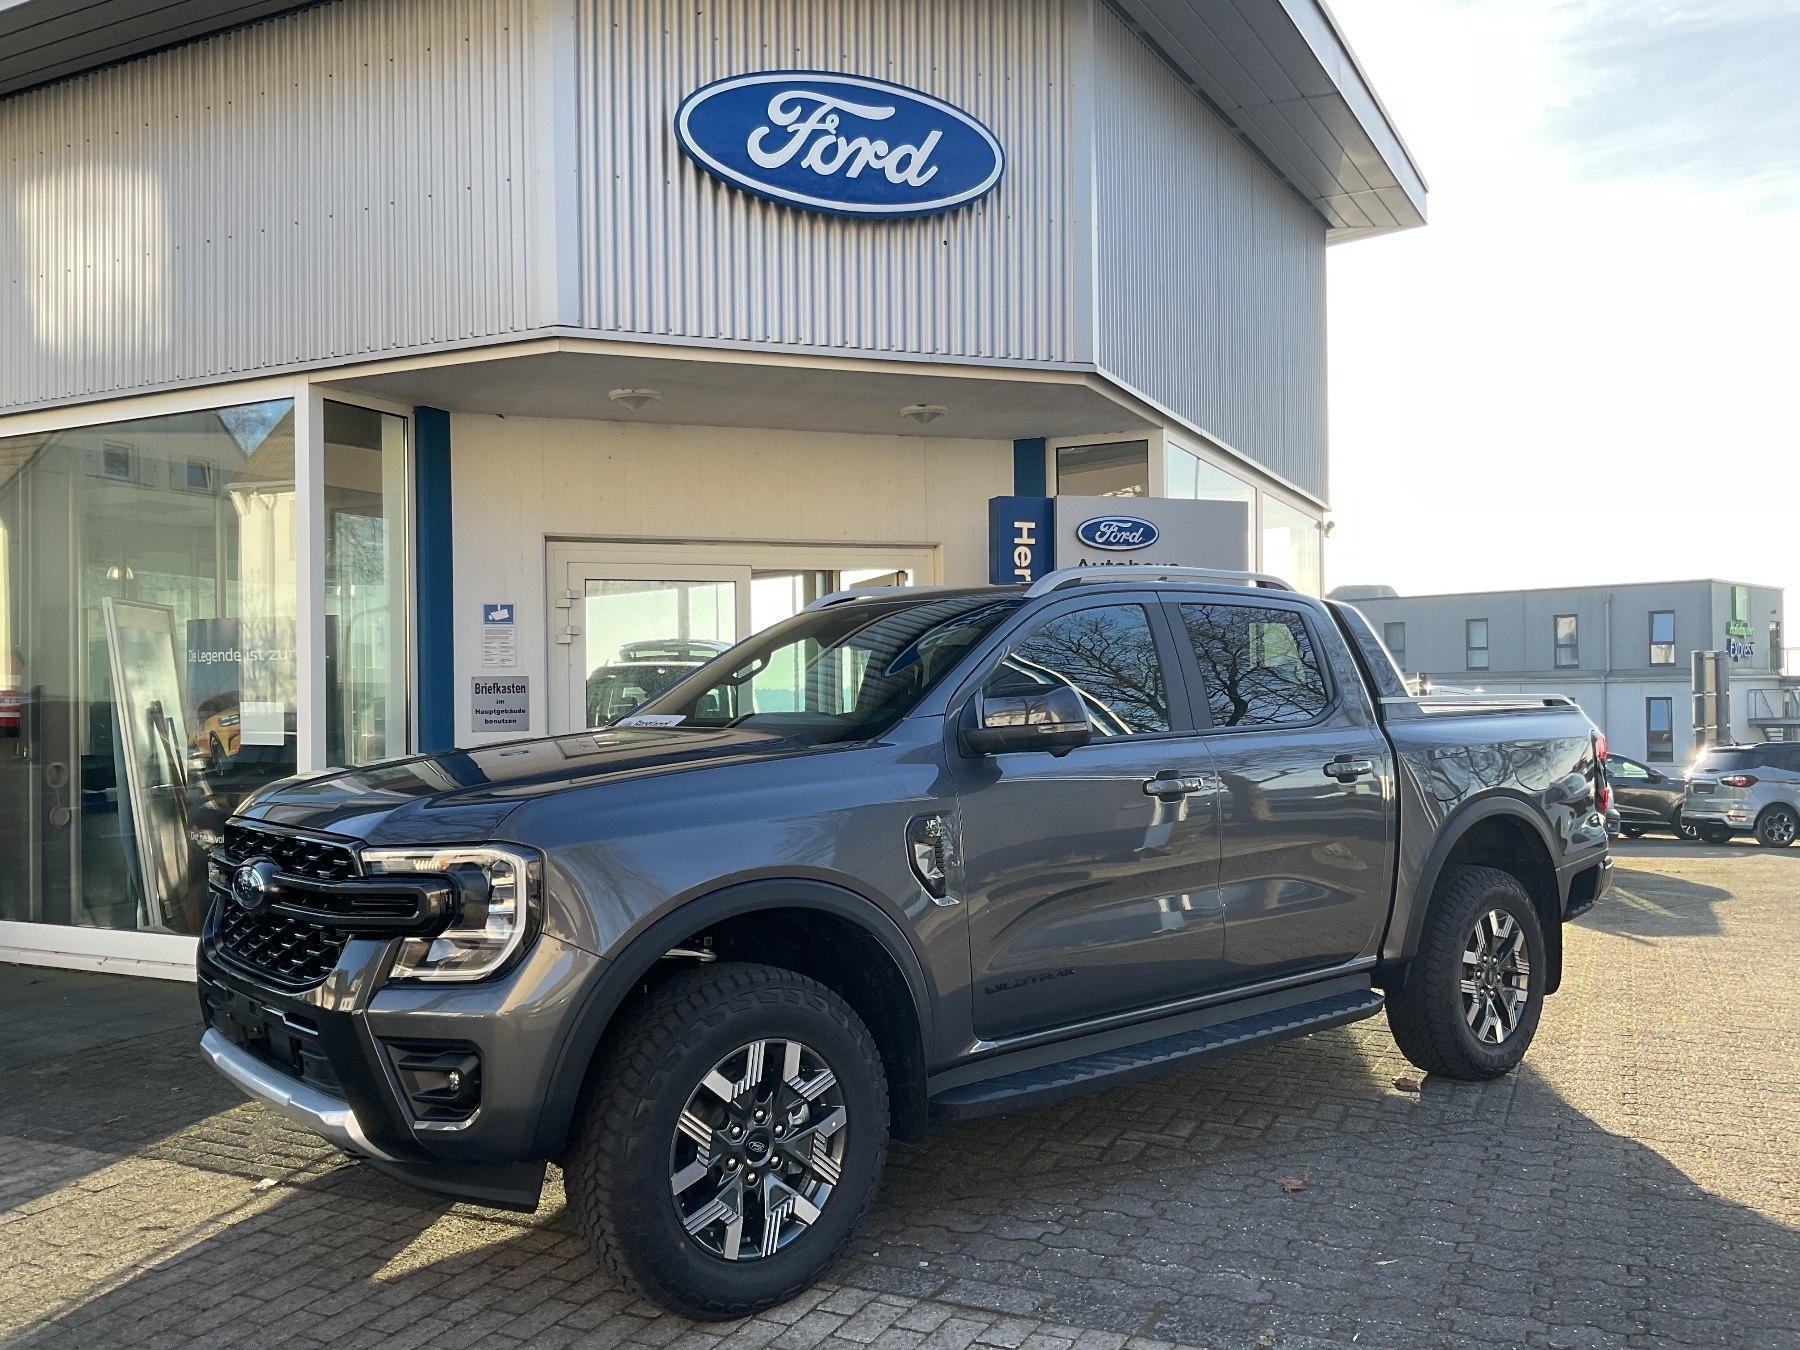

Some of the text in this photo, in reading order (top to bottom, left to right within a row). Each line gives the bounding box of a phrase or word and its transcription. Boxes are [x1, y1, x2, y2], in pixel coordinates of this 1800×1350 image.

[747, 90, 943, 187] Ford
[1095, 521, 1143, 543] Ford
[197, 647, 242, 665] Legende
[246, 646, 264, 661] ist
[474, 682, 526, 695] Briefkasten
[475, 708, 526, 716] Hauptgebäude
